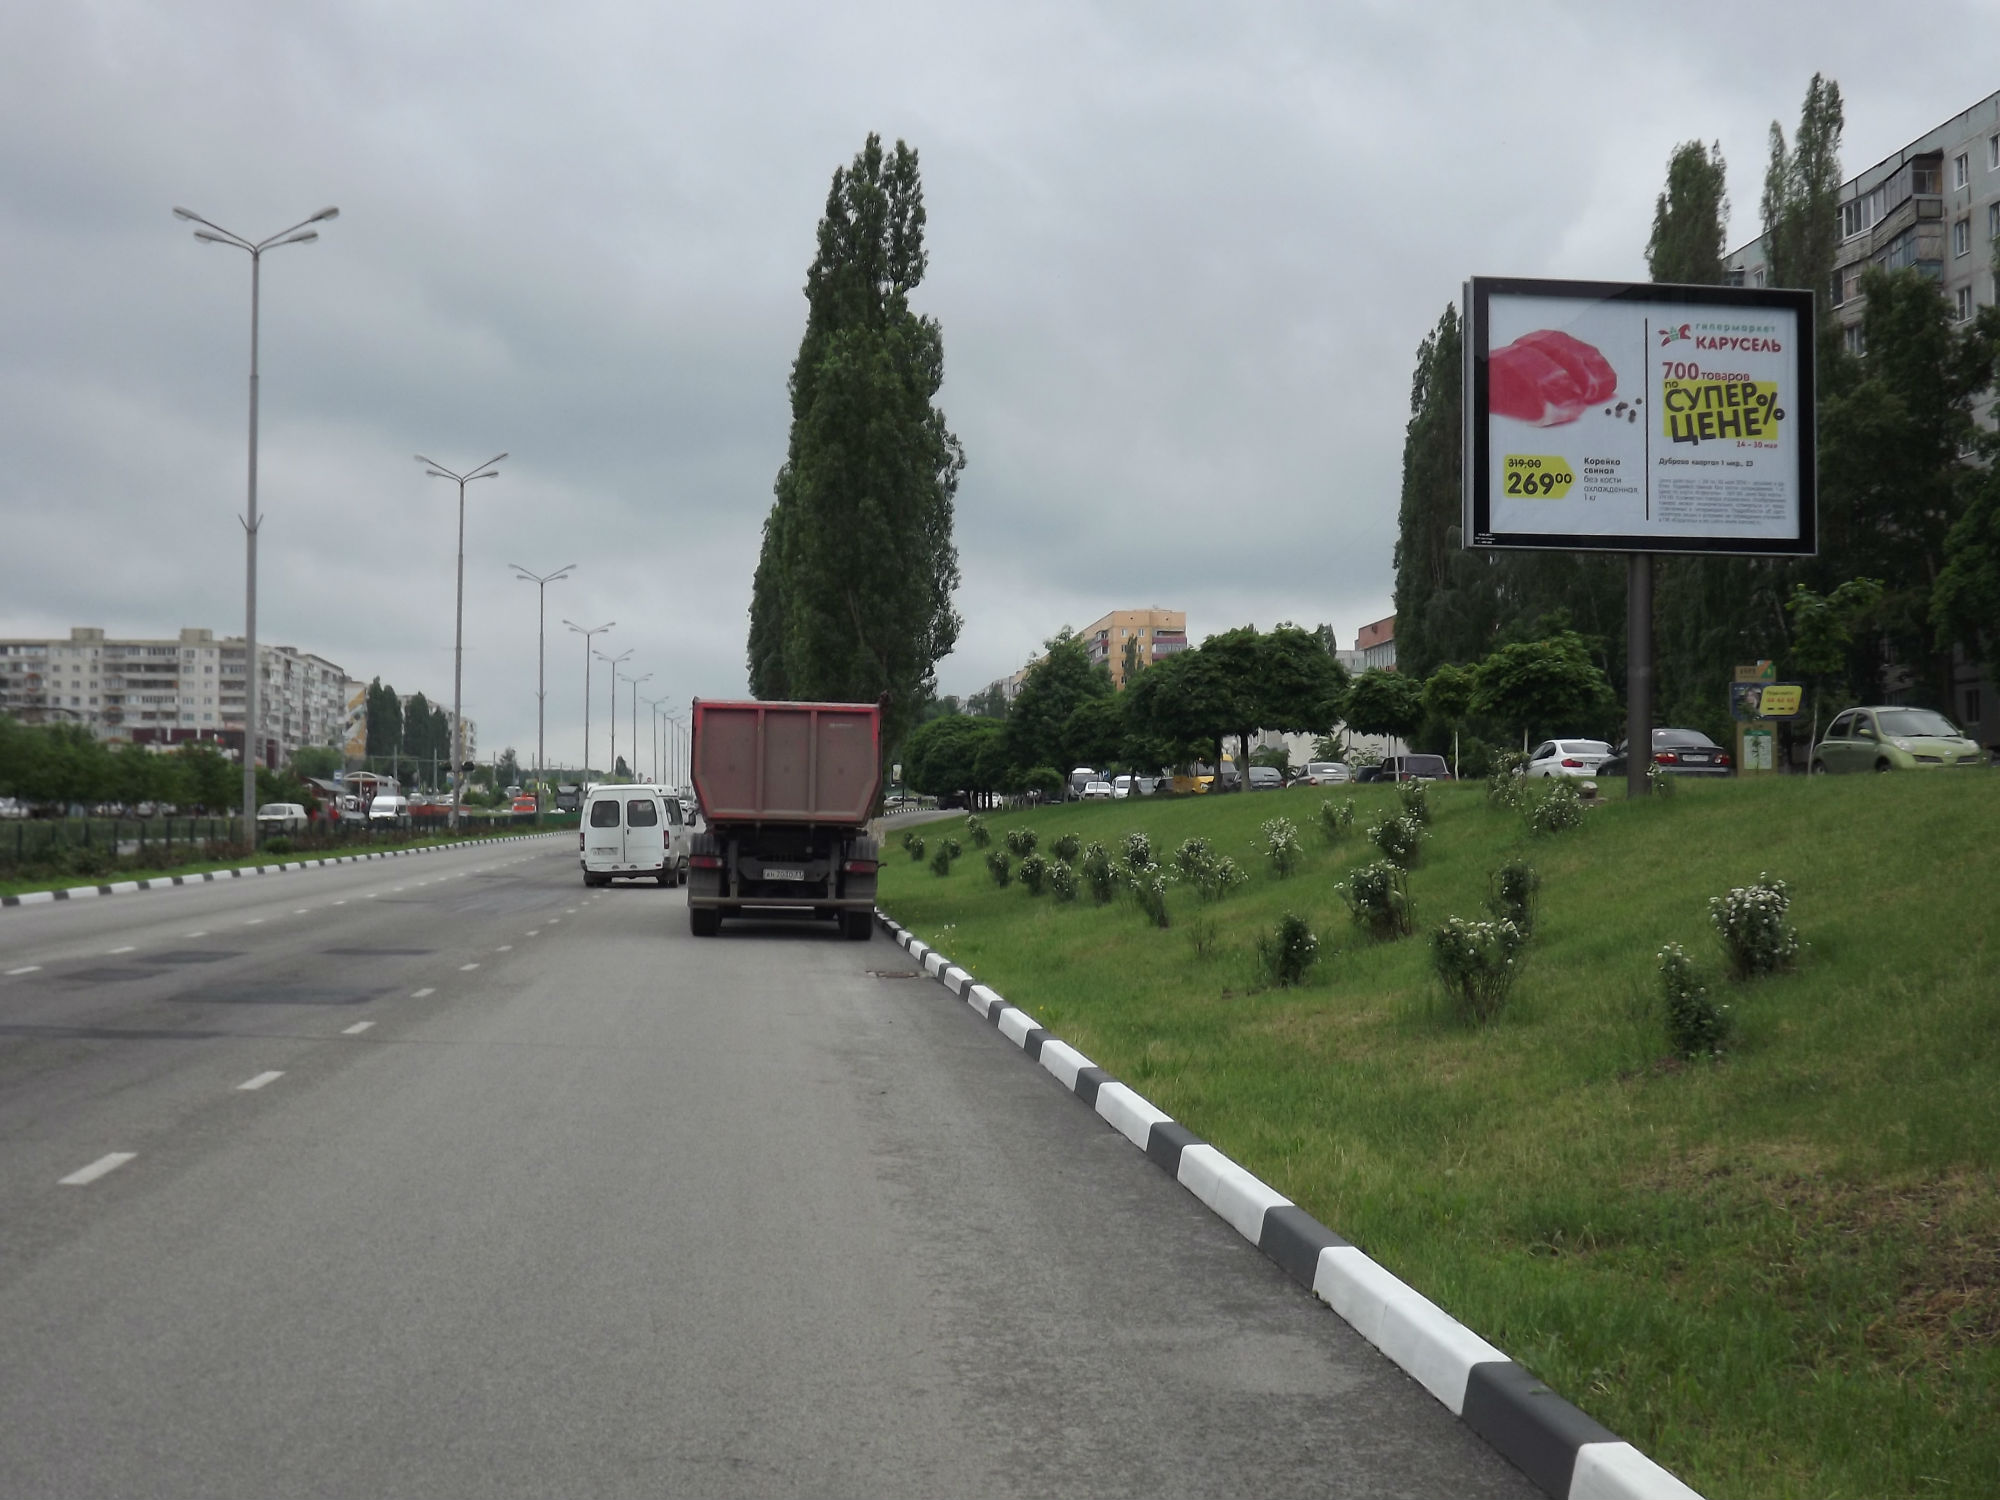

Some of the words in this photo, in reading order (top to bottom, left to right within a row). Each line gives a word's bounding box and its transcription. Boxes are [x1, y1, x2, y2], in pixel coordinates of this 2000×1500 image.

[1695, 323, 1776, 333] гипермаркет
[1695, 336, 1782, 353] КАРУСЕЛЬ
[1662, 361, 1699, 380] 700
[1701, 372, 1750, 382] товаров
[1664, 381, 1679, 389] по
[1665, 382, 1758, 413] СУПЕР
[1670, 407, 1762, 446] ЦЕНЕ
